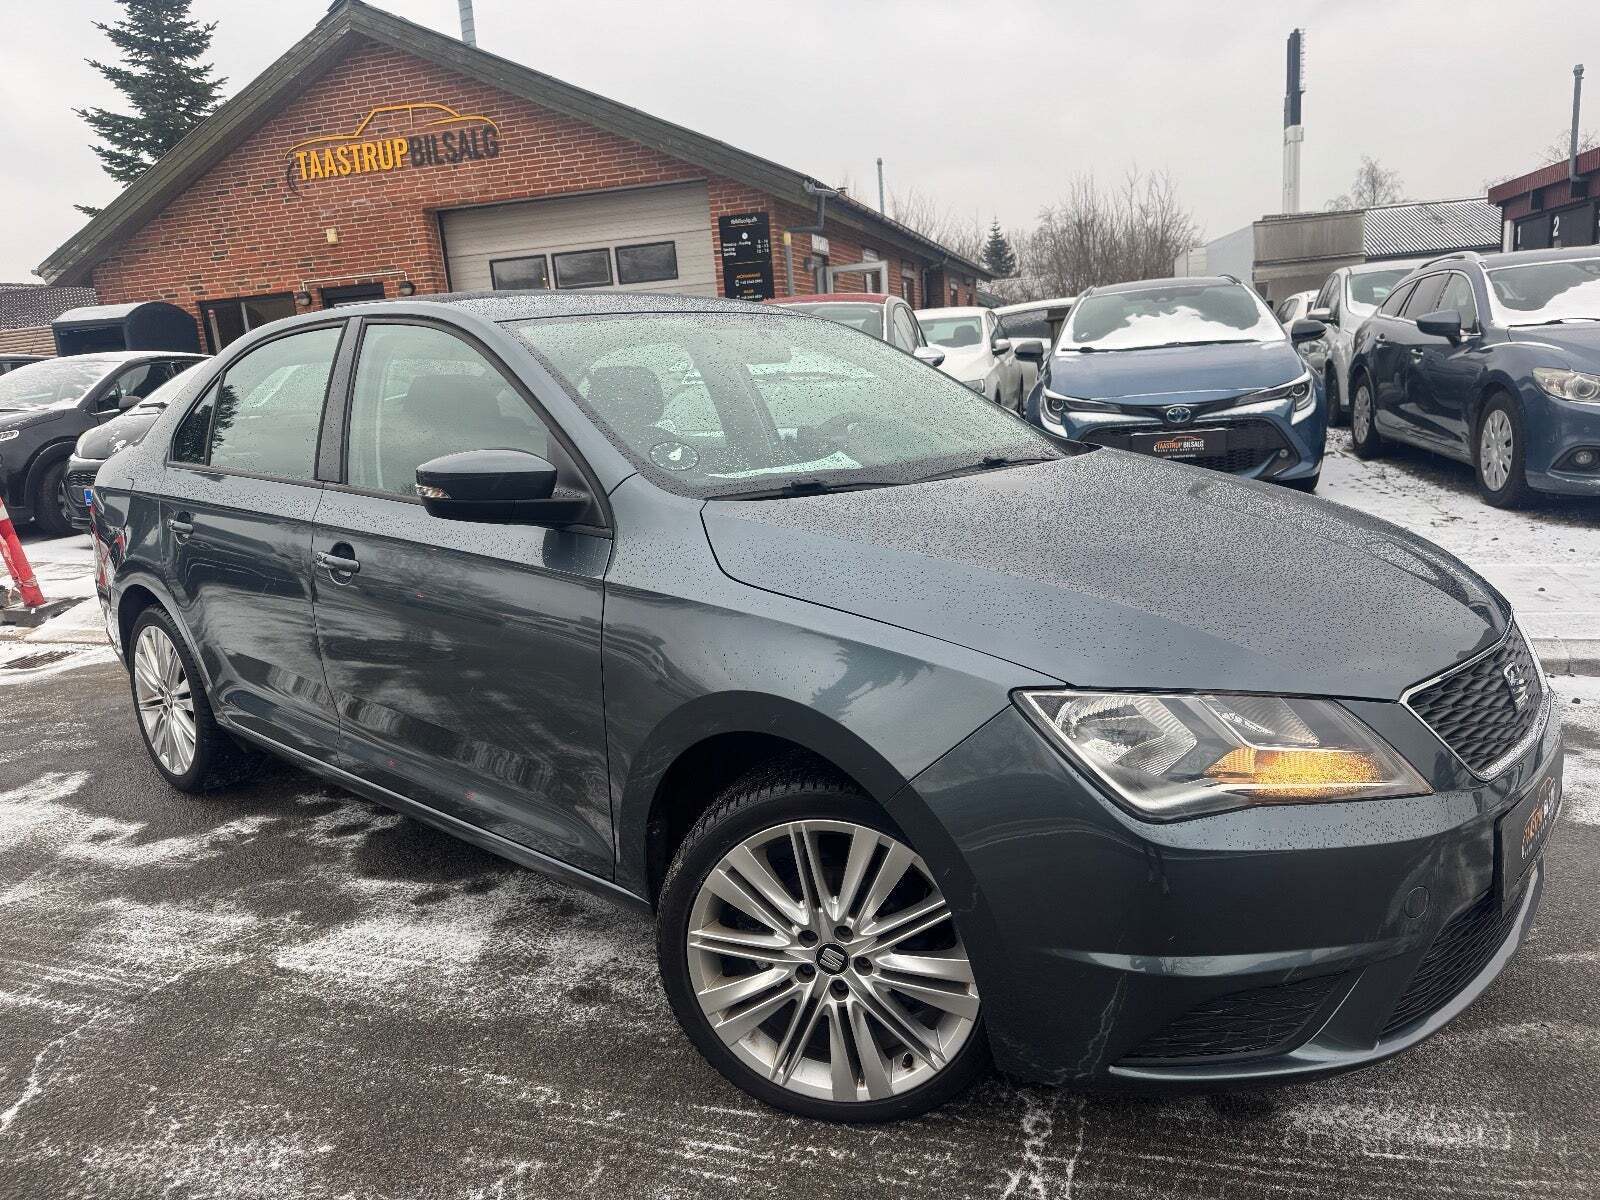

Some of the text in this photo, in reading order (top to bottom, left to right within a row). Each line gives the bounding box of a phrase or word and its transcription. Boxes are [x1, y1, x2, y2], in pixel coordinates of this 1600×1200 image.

[296, 125, 499, 181] TAASTRUP BILSALG
[1552, 215, 1560, 238] 2
